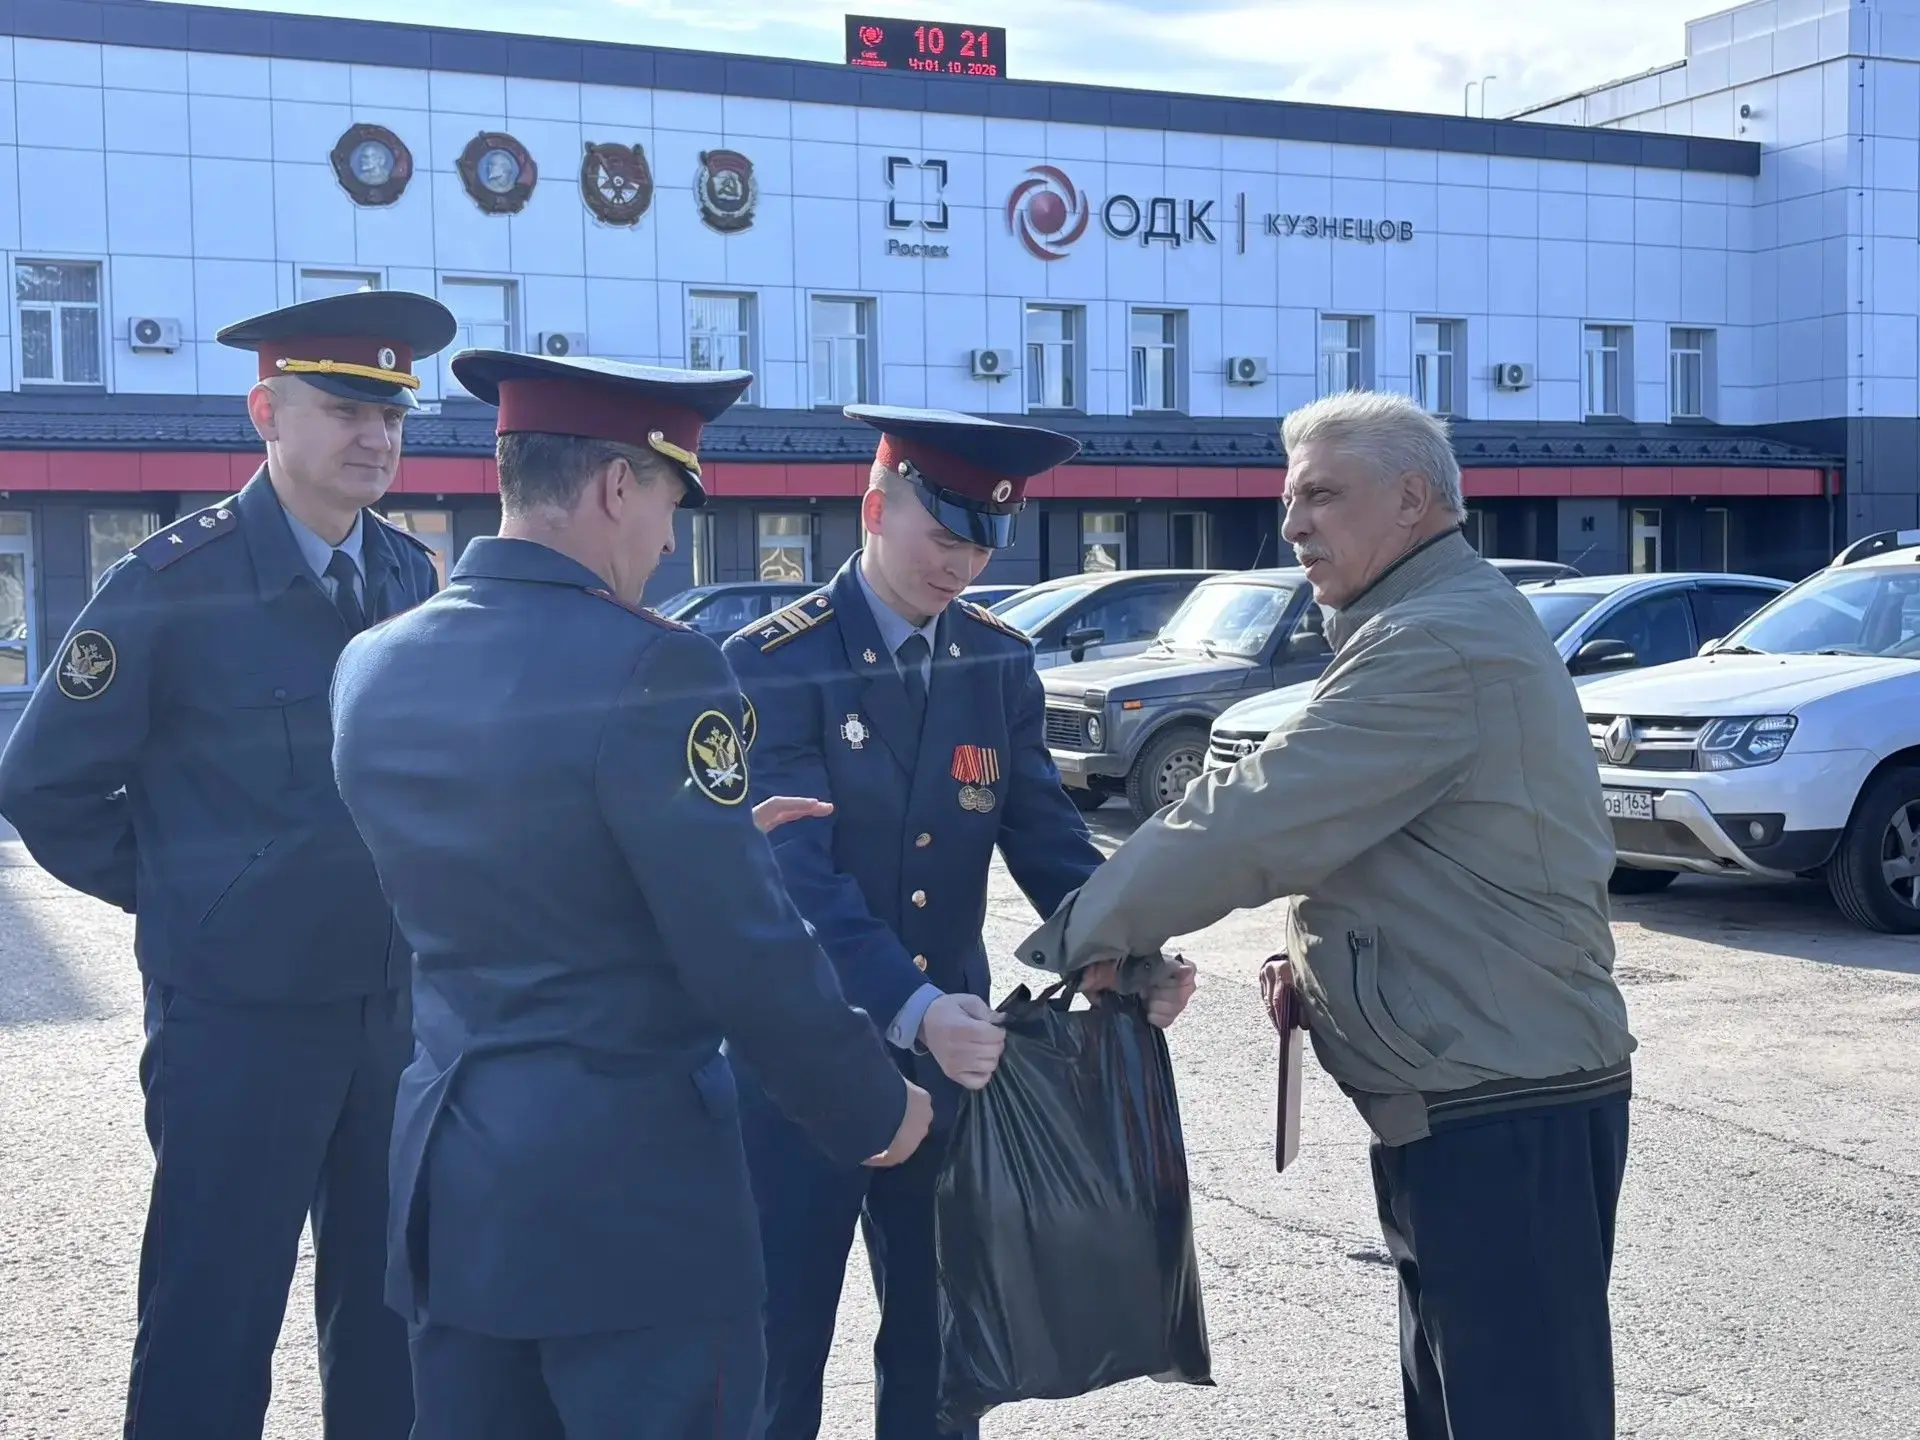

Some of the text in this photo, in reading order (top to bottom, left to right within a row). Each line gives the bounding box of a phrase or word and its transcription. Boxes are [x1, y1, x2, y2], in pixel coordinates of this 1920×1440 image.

[914, 25, 989, 57] 10 21
[1104, 194, 1414, 247] ОДК КУЗНЕЦОВ
[886, 238, 949, 258] Ростех
[1624, 794, 1650, 810] 163
